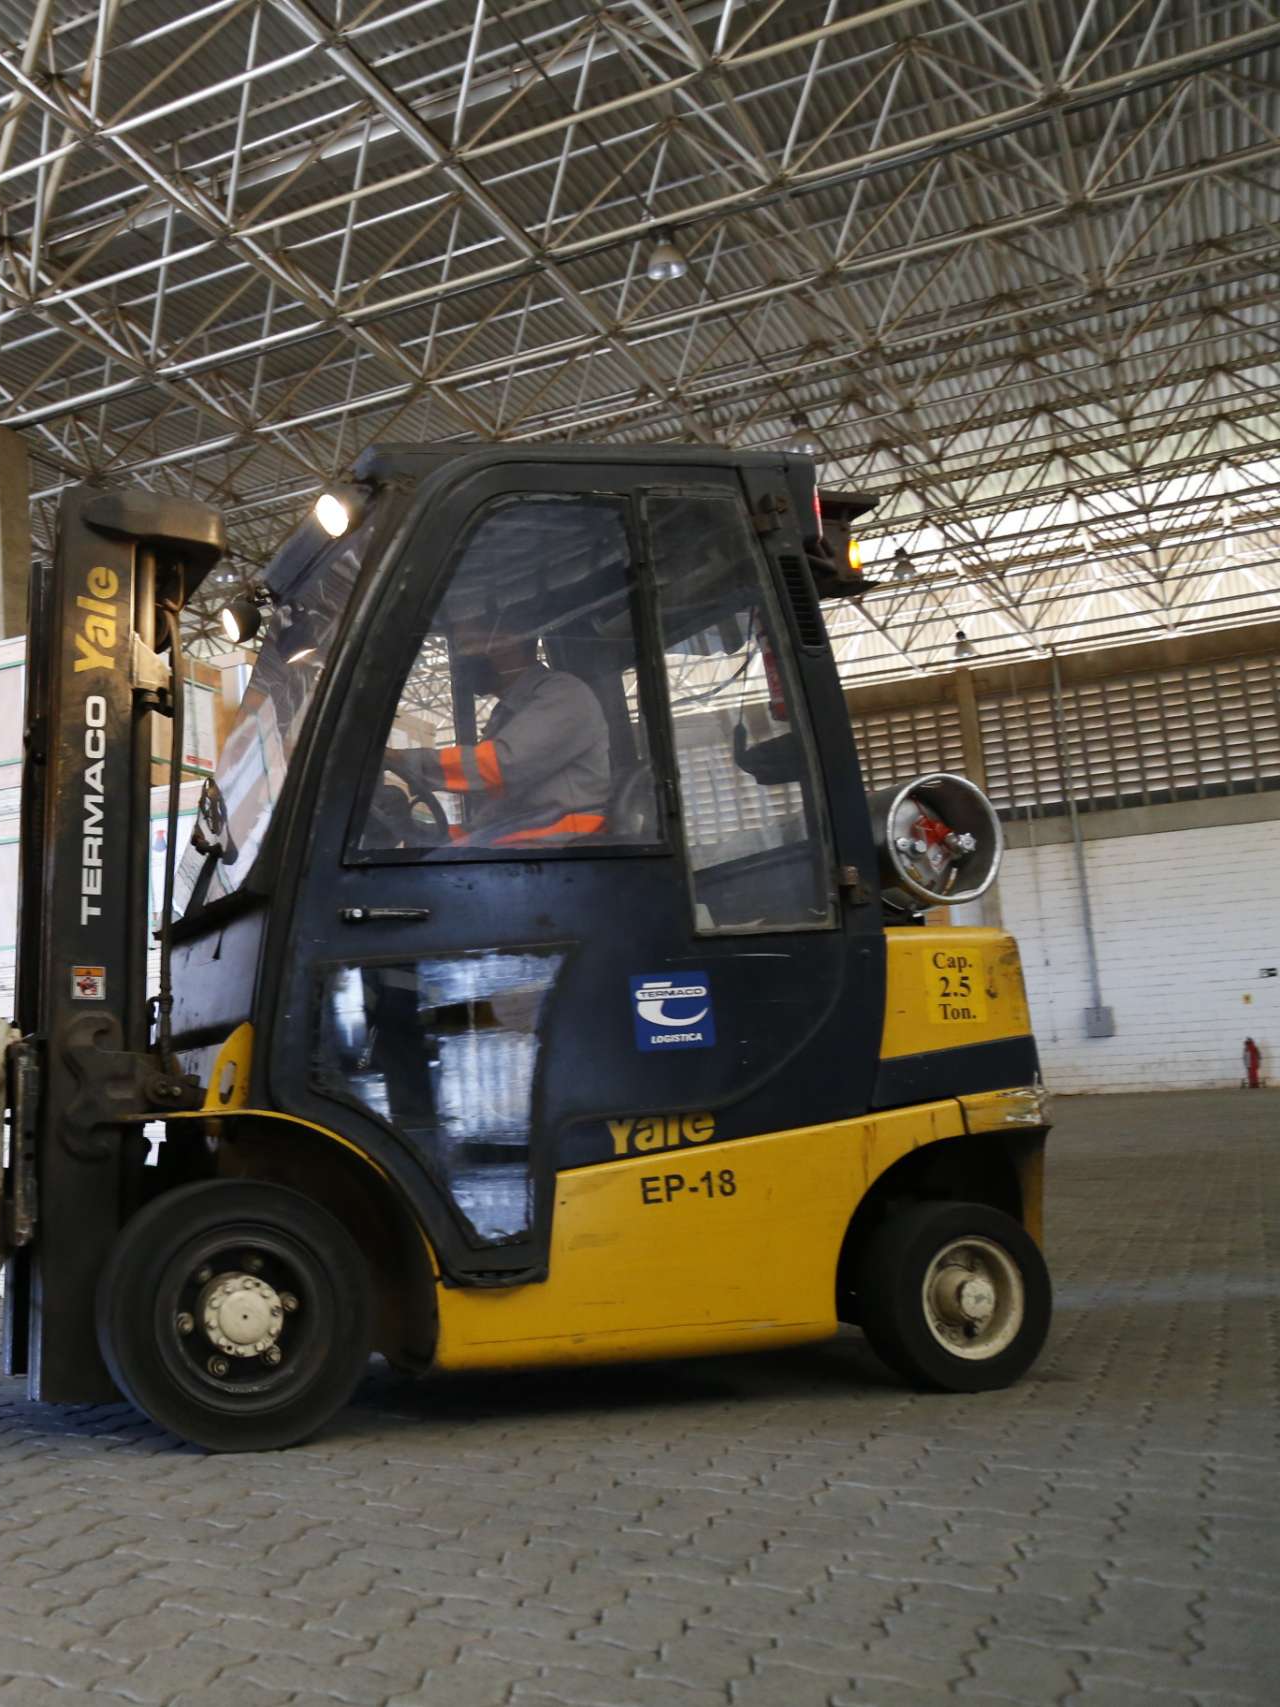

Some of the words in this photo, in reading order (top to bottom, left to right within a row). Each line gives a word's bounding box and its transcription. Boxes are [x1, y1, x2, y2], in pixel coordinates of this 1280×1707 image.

[74, 566, 119, 672] Yale
[81, 695, 107, 925] TERMACO
[932, 952, 972, 972] Cap.
[639, 988, 703, 998] TERMACO
[939, 976, 972, 997] 2.5
[938, 1003, 976, 1020] Ton.
[651, 1033, 703, 1044] LOGISTICA
[607, 1112, 714, 1155] Yale
[640, 1169, 736, 1205] EP-18
